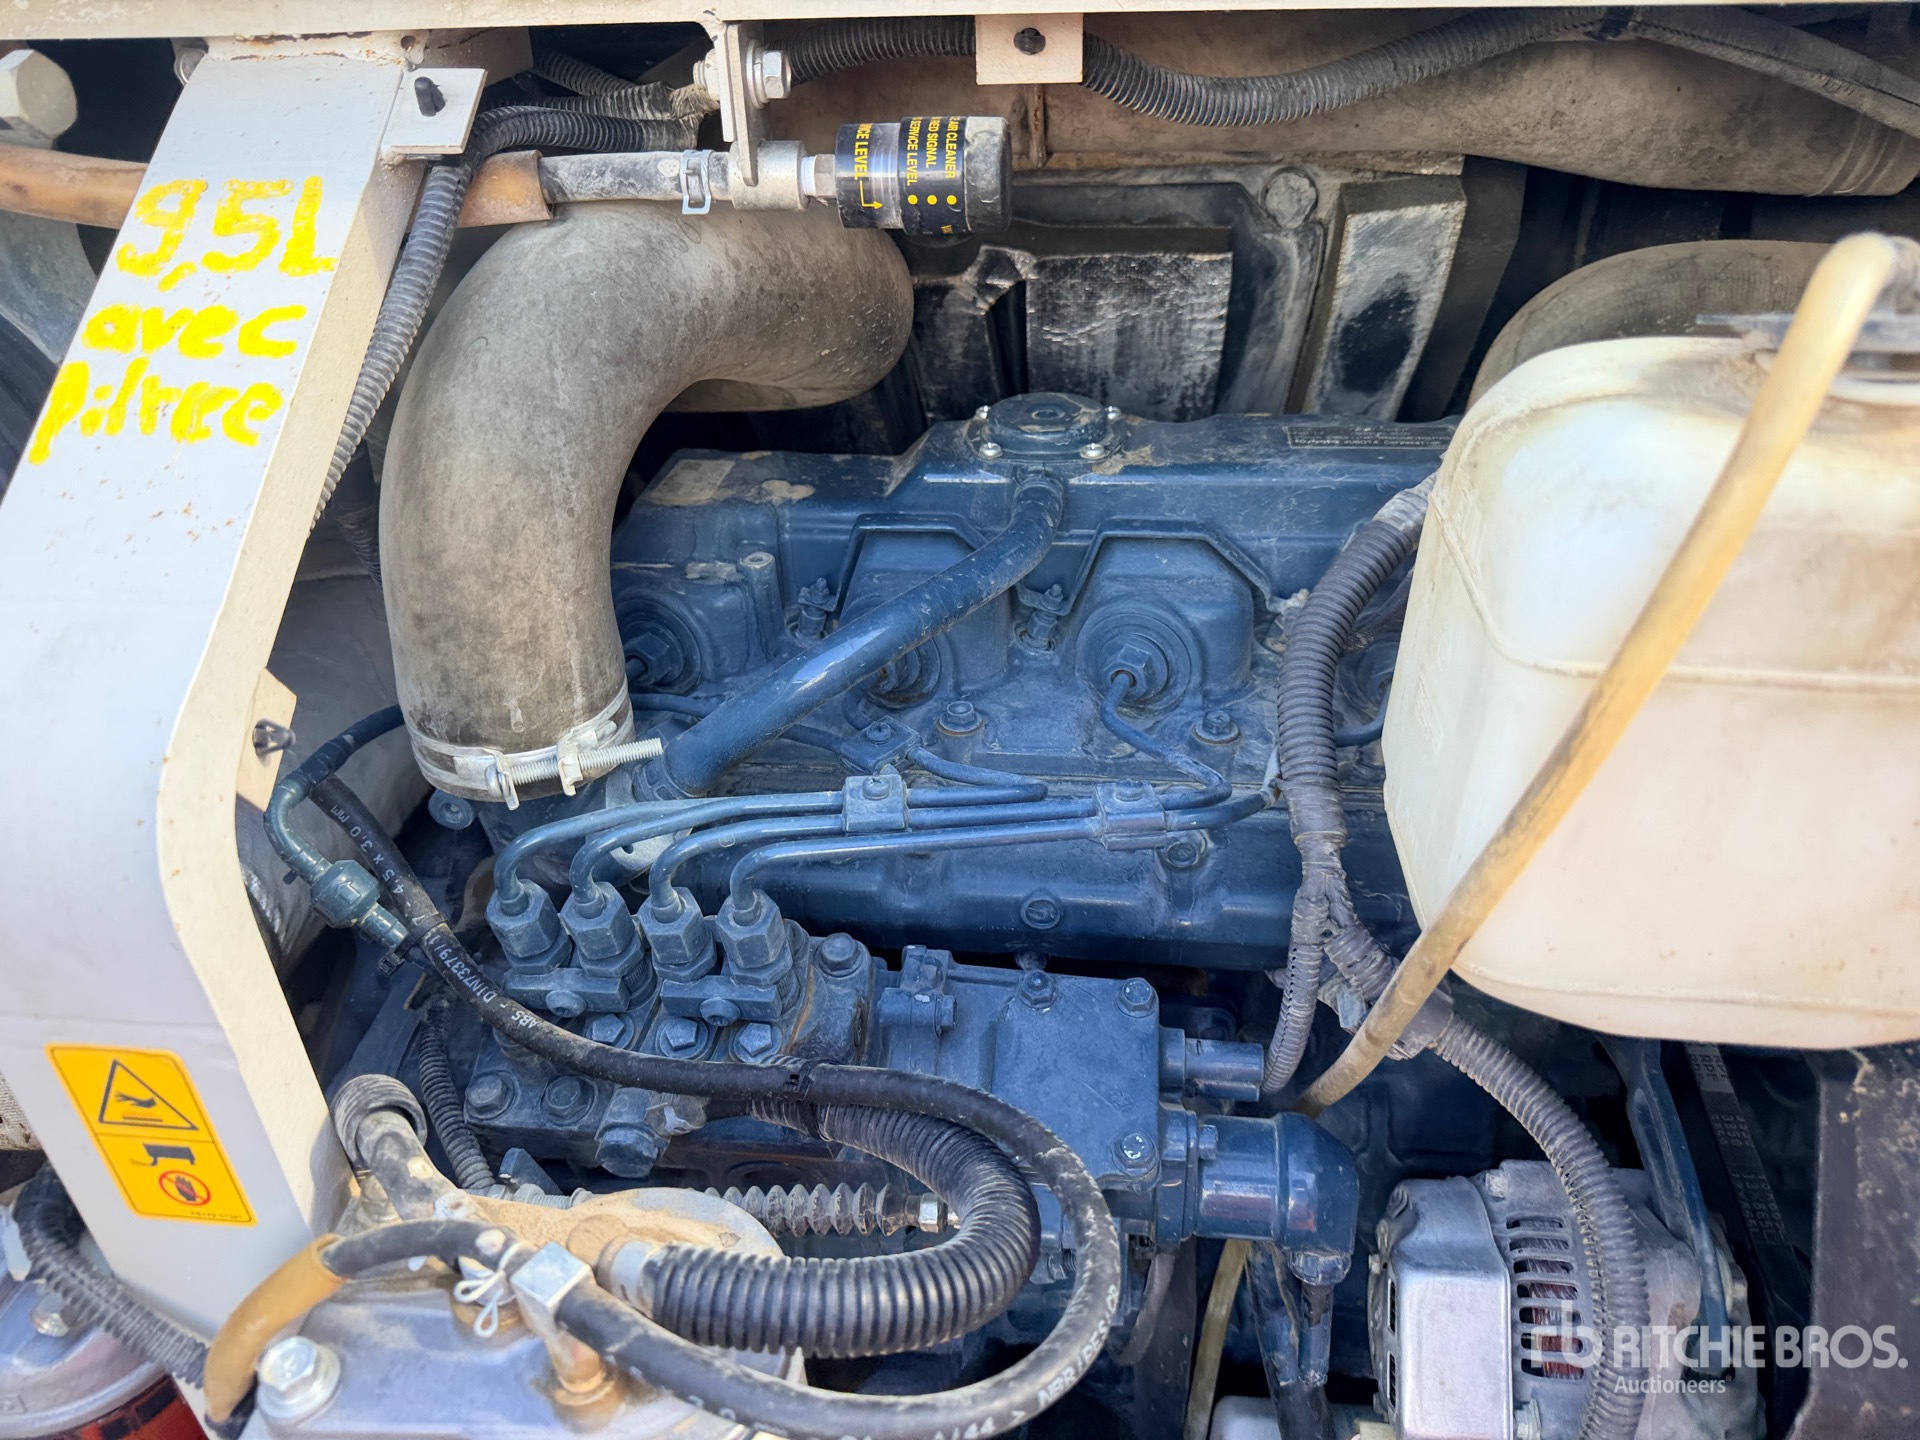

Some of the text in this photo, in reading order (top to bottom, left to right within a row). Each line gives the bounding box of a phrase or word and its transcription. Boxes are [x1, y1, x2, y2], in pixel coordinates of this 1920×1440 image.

[854, 141, 868, 180] LEVEL
[906, 152, 918, 186] LEVEL
[926, 132, 939, 168] SIGNAL
[945, 132, 958, 179] CLEANER
[81, 303, 307, 359] avec
